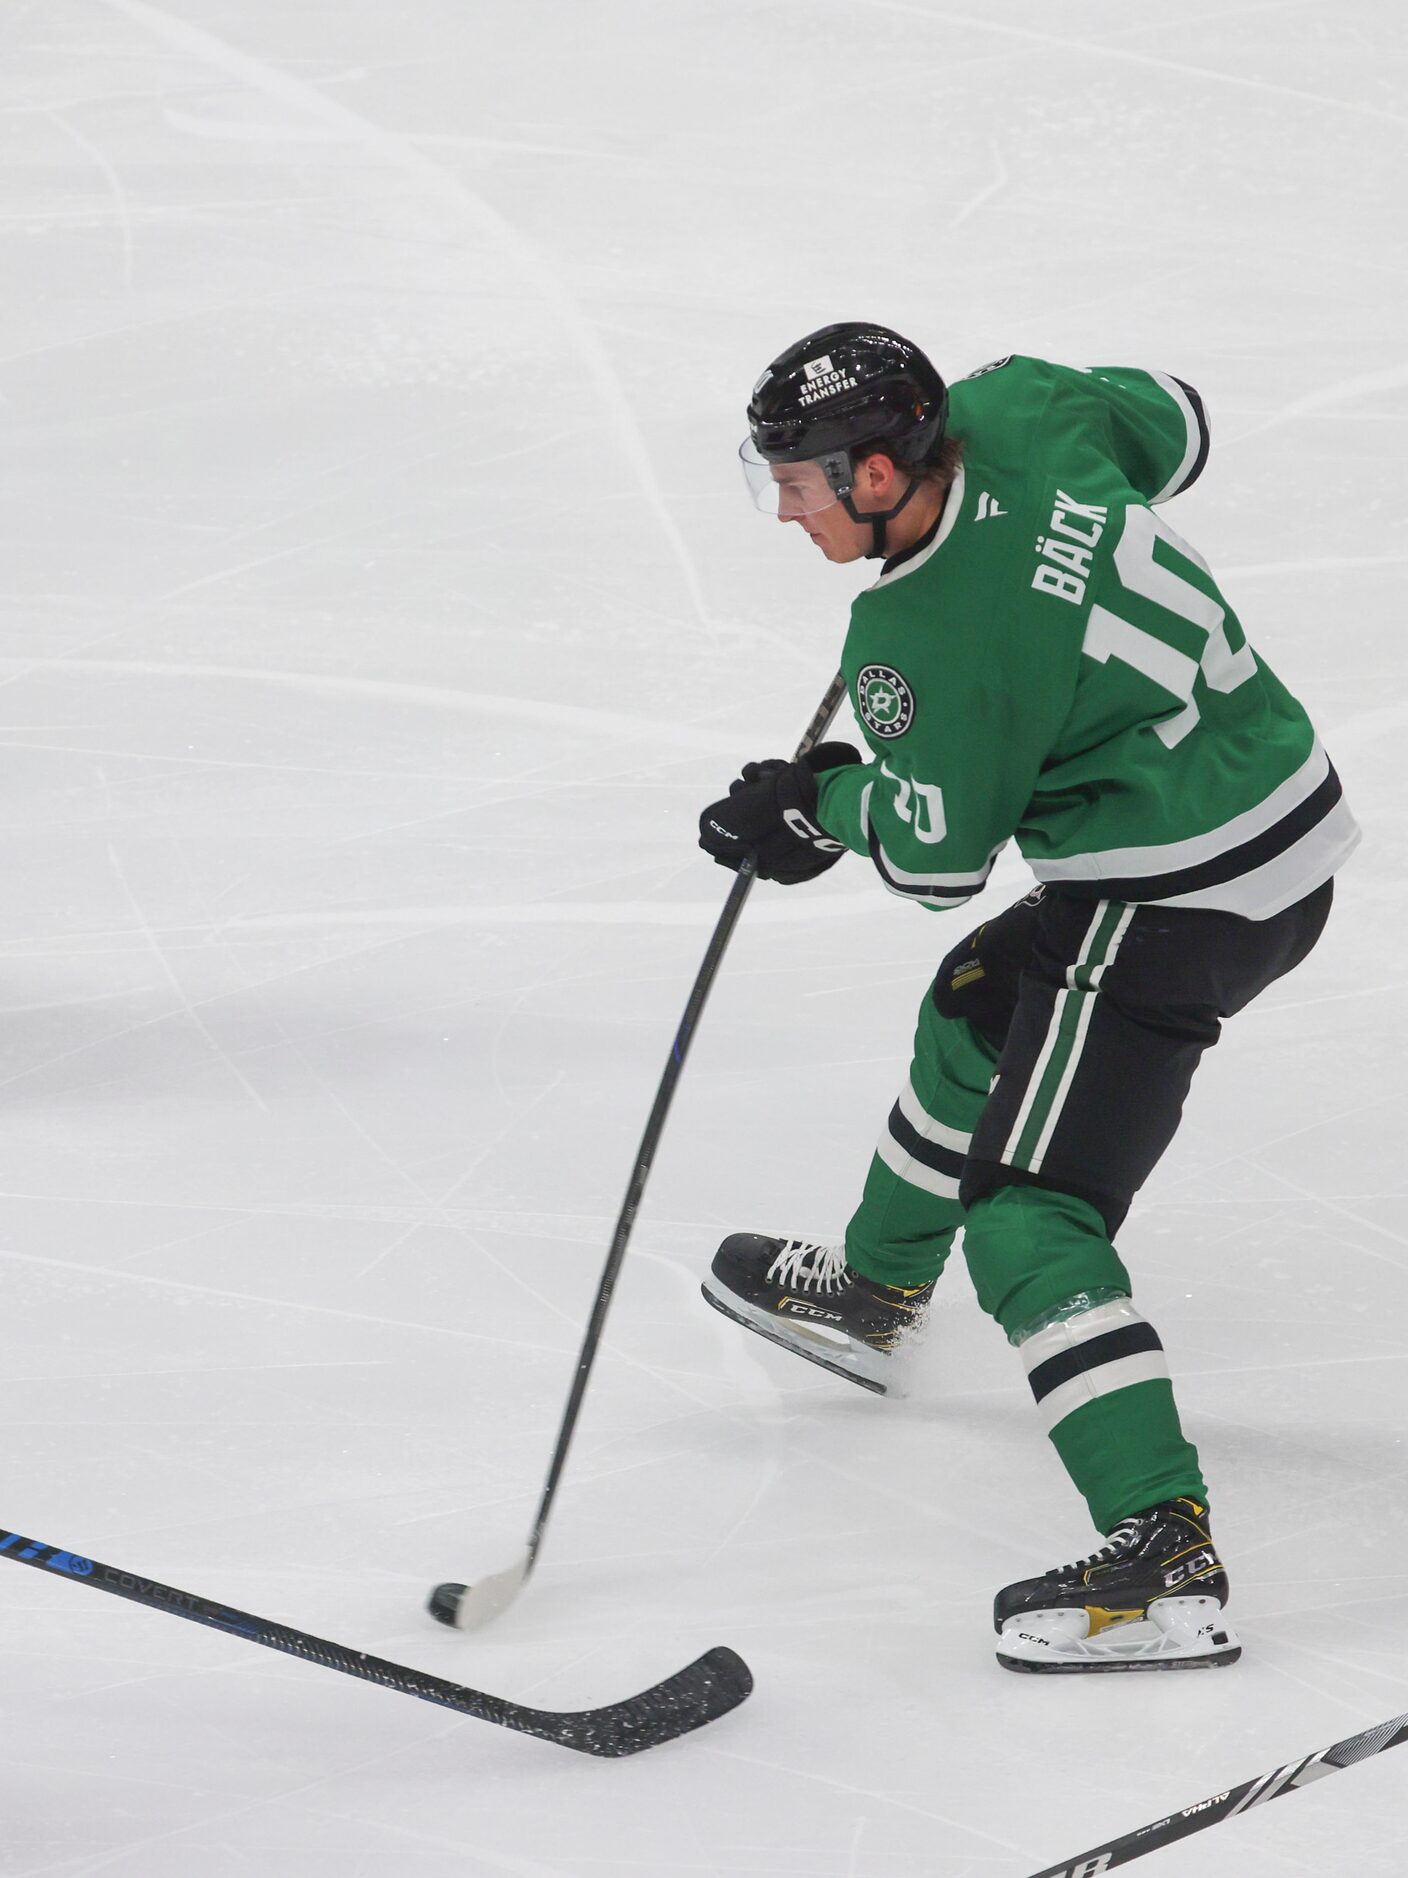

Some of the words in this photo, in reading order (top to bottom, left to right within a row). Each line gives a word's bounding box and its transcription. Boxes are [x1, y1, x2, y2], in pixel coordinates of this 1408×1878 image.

[798, 376, 859, 407] TRANSFER
[800, 368, 847, 395] ENERGY
[1031, 488, 1108, 606] BÄCK
[1081, 503, 1260, 750] 10
[859, 670, 906, 695] DALLAS
[864, 712, 908, 733] STARS
[709, 820, 739, 840] CCM
[790, 1304, 843, 1321] CCM
[104, 1568, 200, 1612] COVERT
[1018, 1632, 1050, 1646] CCM
[1181, 1791, 1231, 1818] ALPHA
